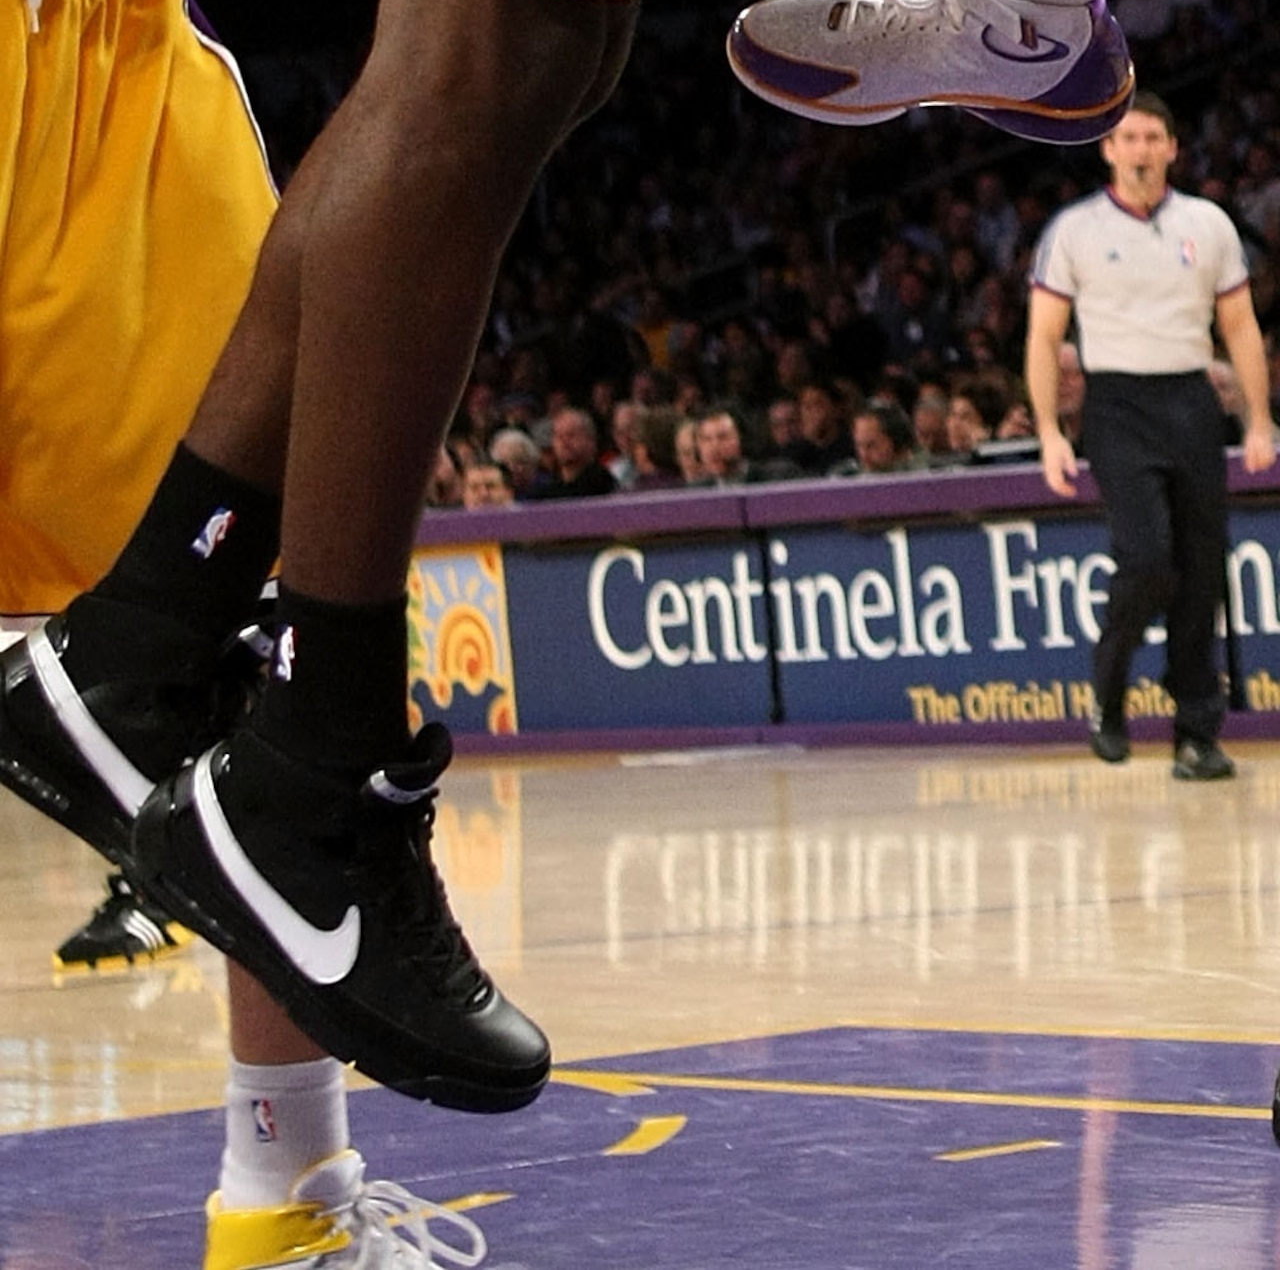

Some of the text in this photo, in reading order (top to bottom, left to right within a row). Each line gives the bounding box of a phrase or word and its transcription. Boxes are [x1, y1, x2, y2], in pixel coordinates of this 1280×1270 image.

[587, 525, 974, 671] Centinela
[907, 686, 962, 724] The
[964, 680, 1064, 723] Official
